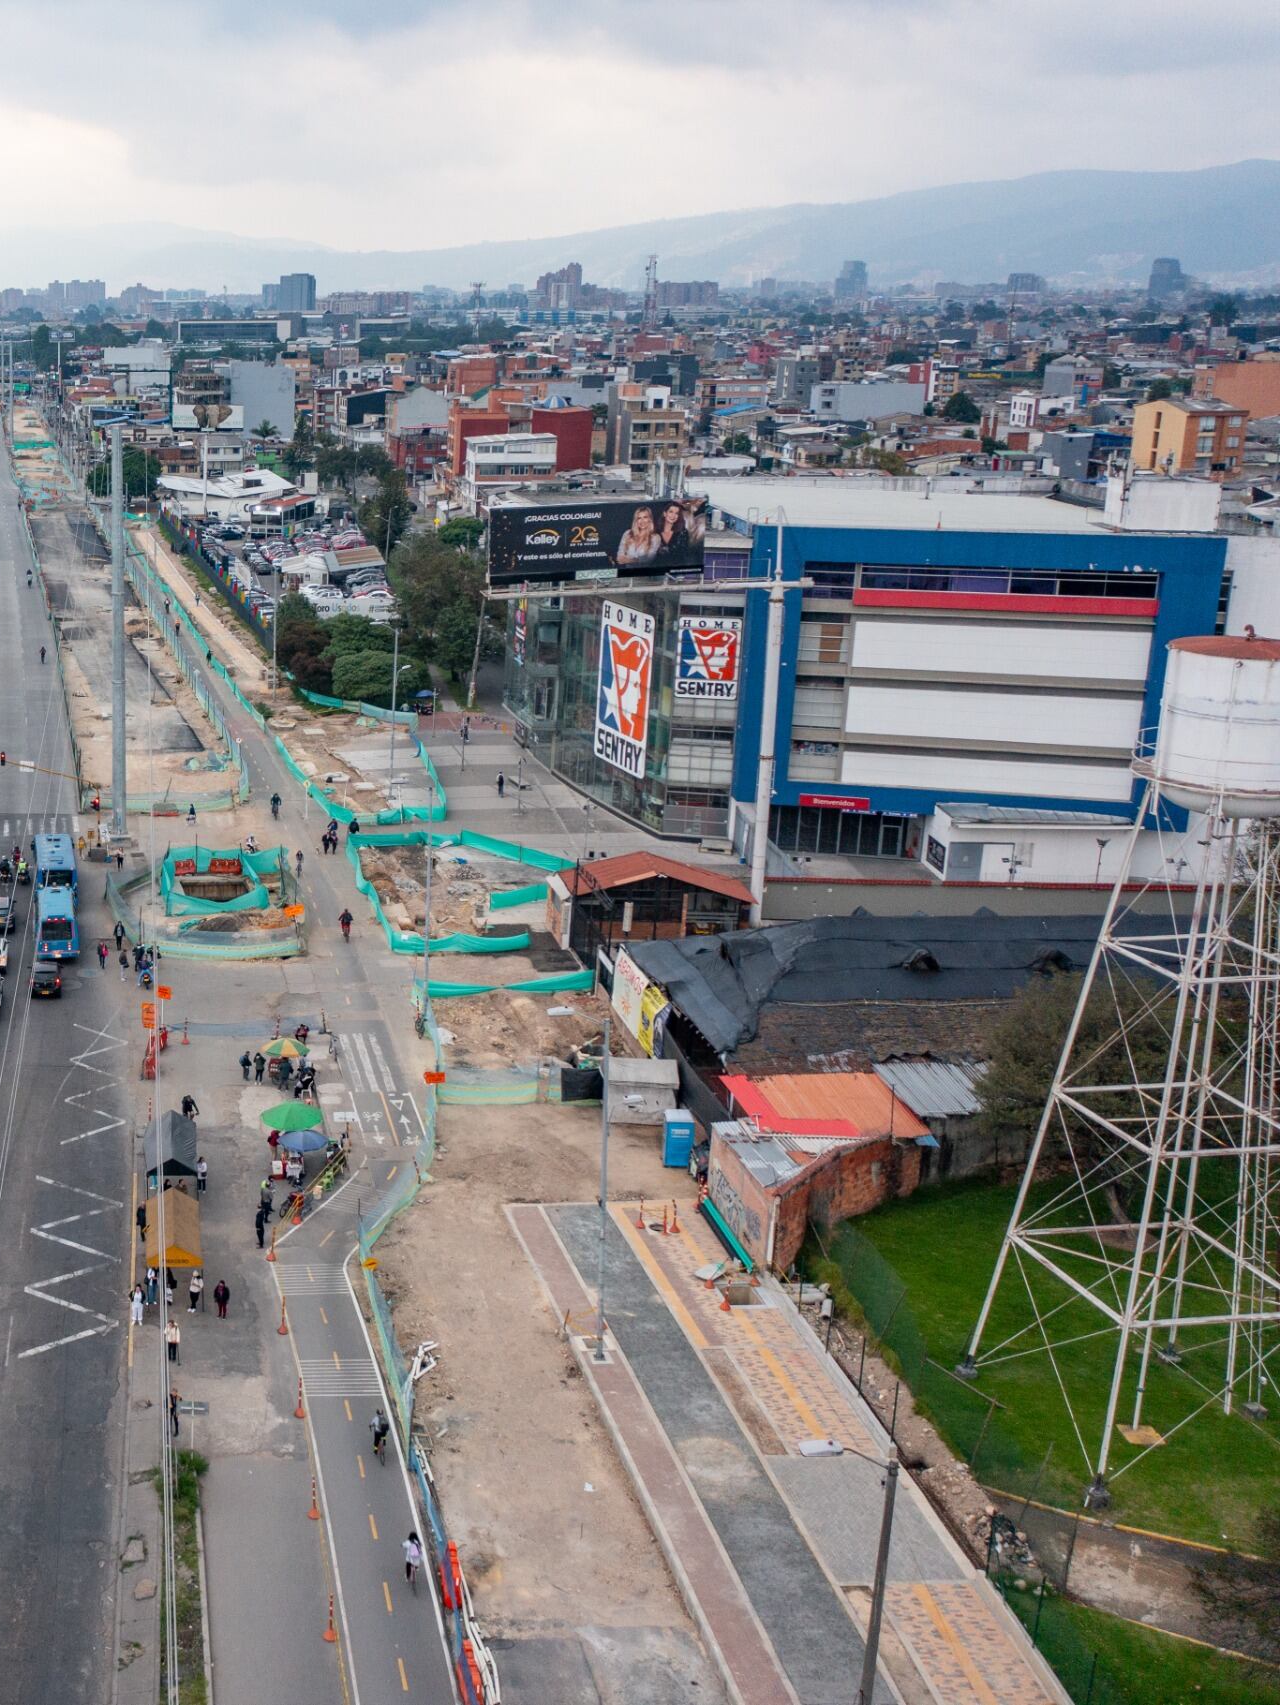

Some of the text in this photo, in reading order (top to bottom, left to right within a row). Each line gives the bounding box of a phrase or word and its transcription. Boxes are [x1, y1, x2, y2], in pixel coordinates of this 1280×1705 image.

[560, 512, 602, 520] COLOMBIA!
[526, 535, 560, 546] Kalley
[603, 604, 652, 634] HOME
[683, 619, 739, 629] HOME
[677, 681, 735, 697] SENTRY
[597, 728, 643, 773] SENTRY
[813, 797, 855, 807] Bienvenidos
